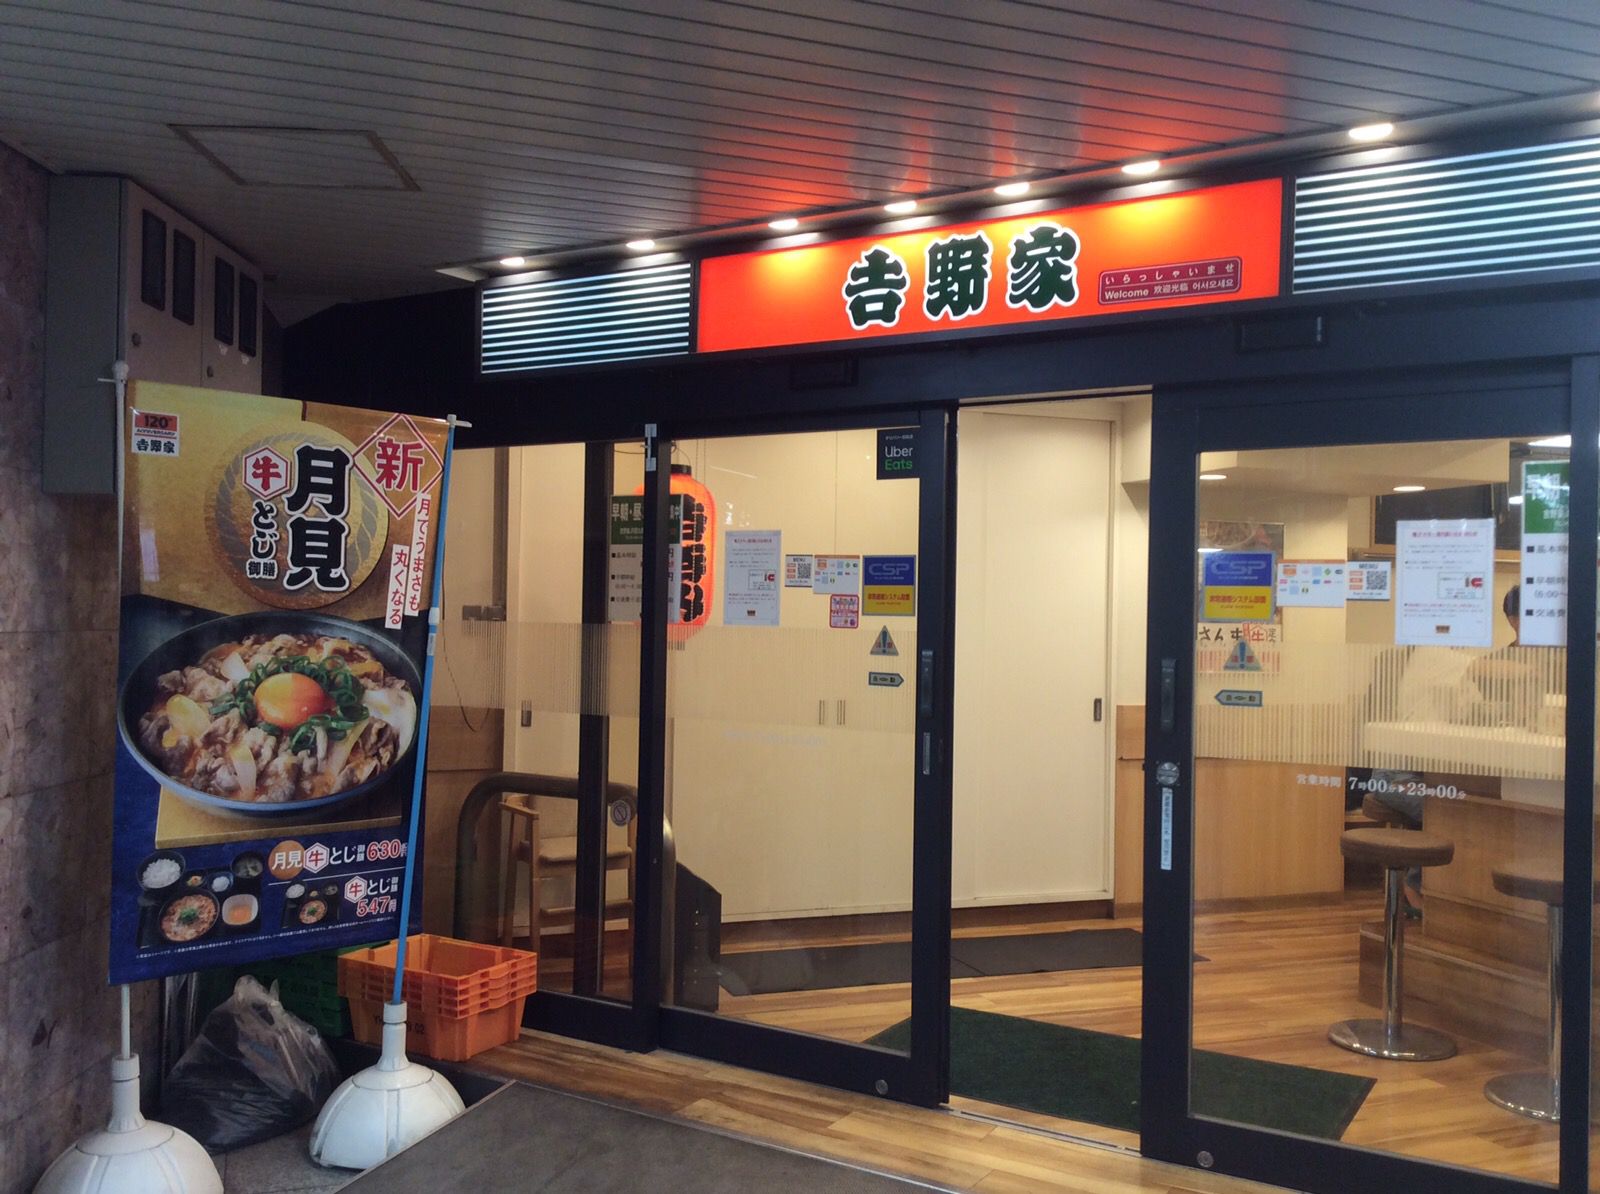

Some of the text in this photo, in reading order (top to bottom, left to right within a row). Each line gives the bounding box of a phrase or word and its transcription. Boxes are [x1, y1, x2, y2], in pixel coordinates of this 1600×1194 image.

[843, 224, 1079, 330] 吉野家
[1105, 263, 1235, 285] いらっしゃいませ
[1104, 289, 1149, 300] Welcome
[1192, 279, 1234, 291] 어서오세요
[884, 445, 914, 458] Uber
[375, 437, 425, 491] 新
[884, 459, 913, 471] Eats
[286, 445, 350, 588] 月見
[868, 563, 910, 575] CSP
[1211, 561, 1266, 575] CSP
[390, 549, 409, 626] 丸くなる
